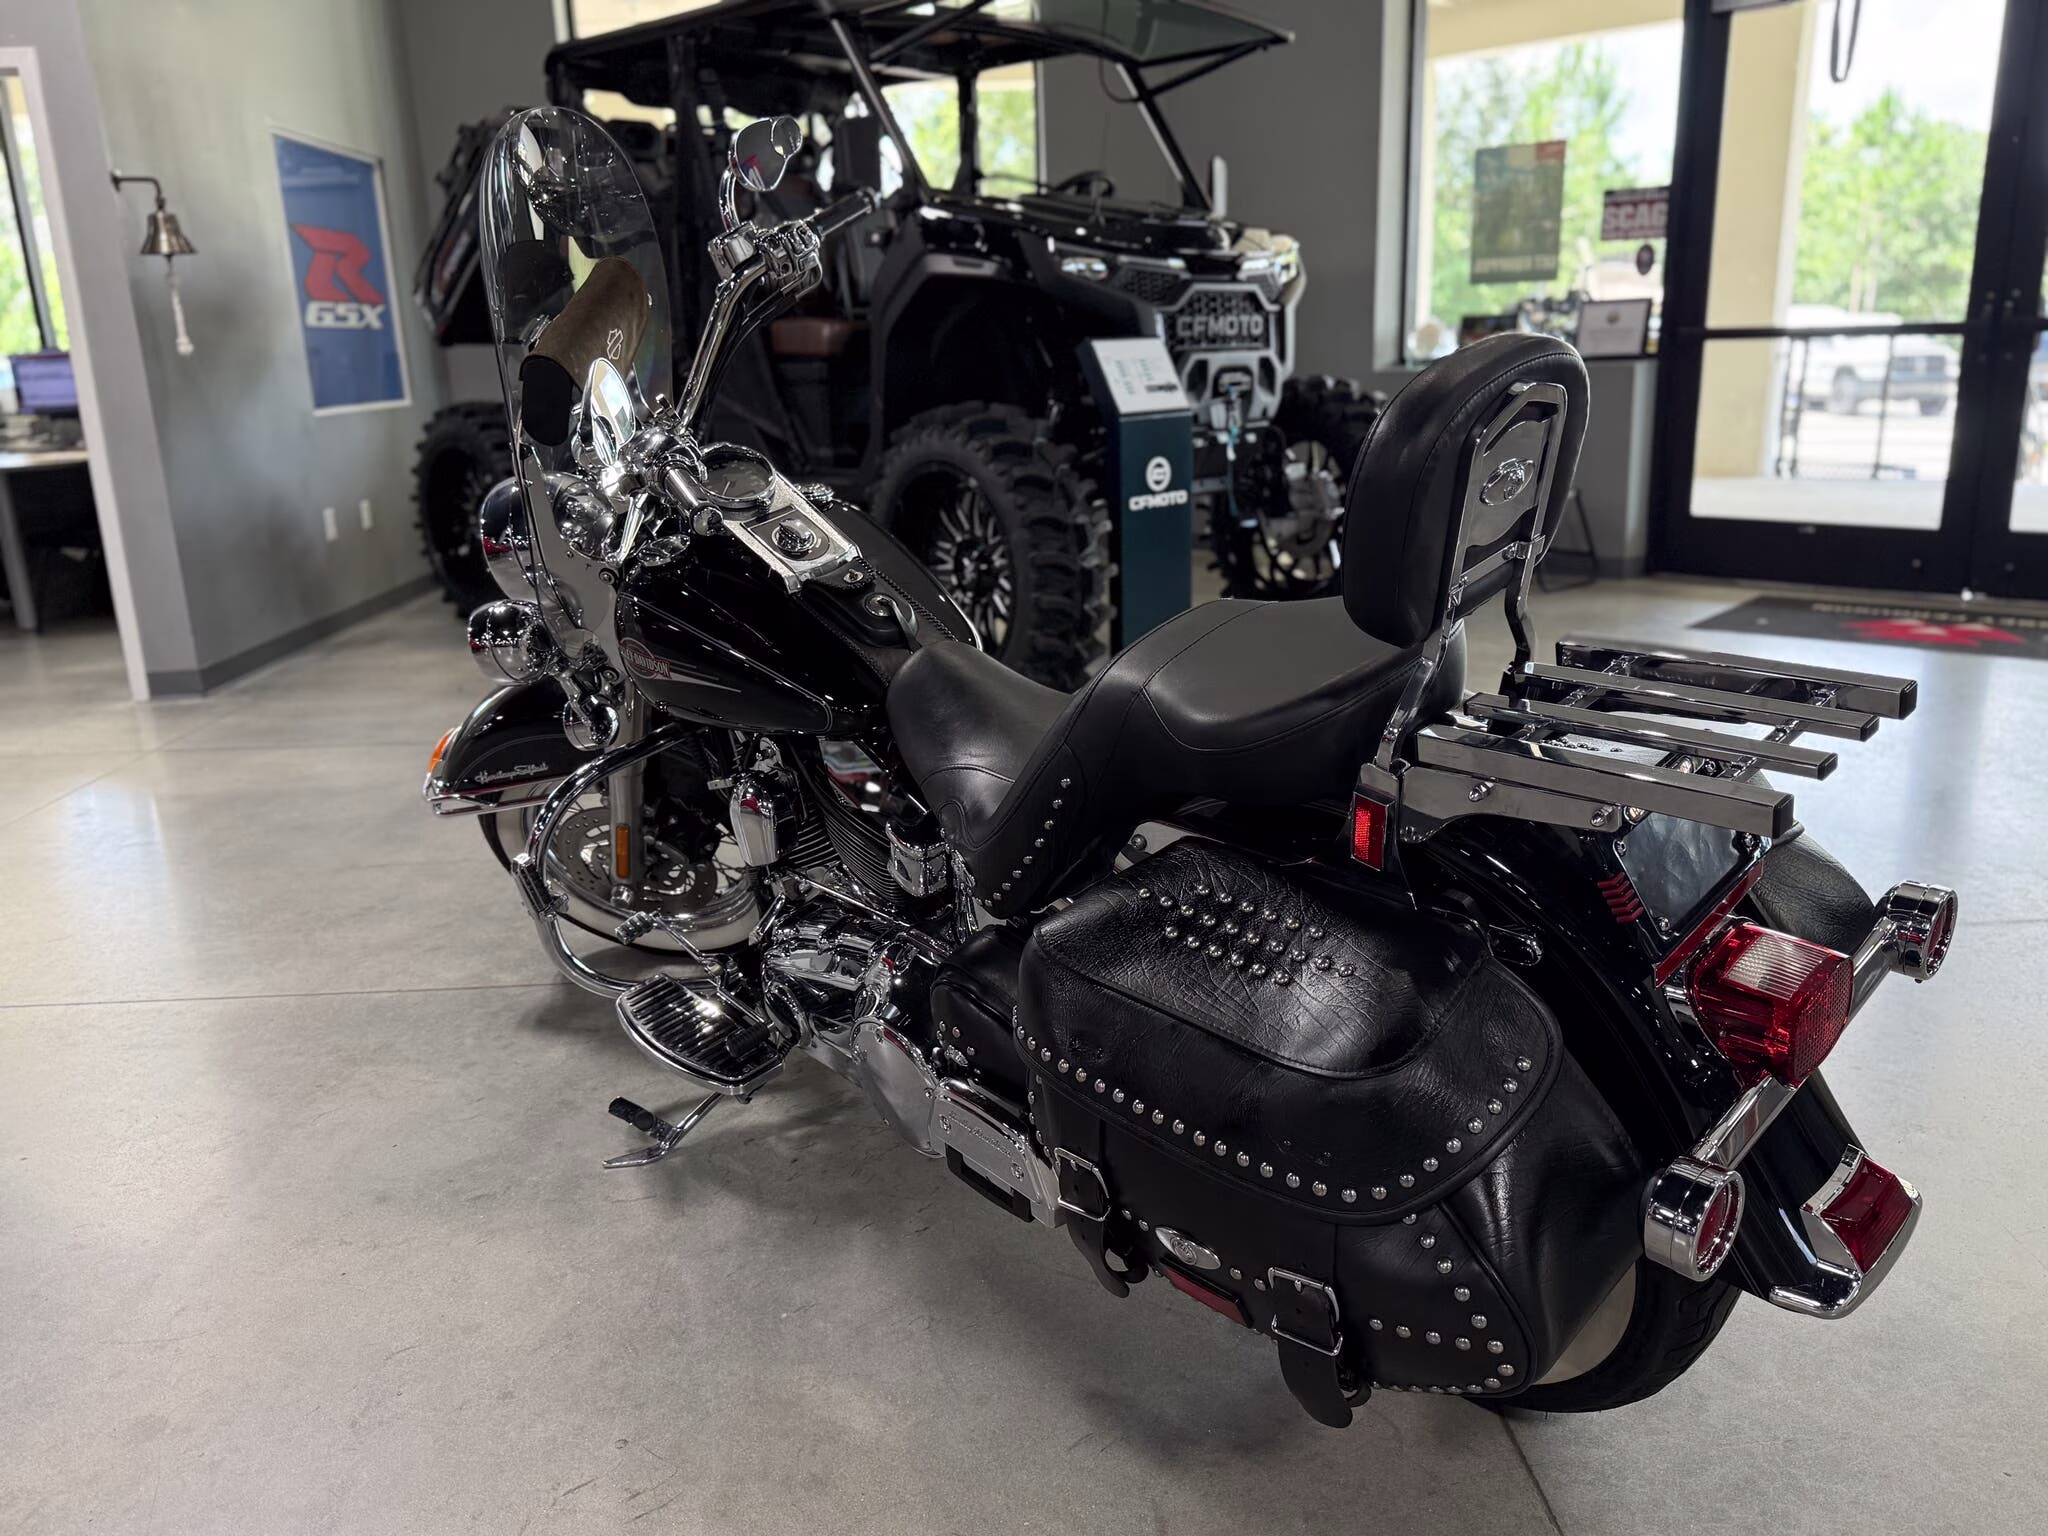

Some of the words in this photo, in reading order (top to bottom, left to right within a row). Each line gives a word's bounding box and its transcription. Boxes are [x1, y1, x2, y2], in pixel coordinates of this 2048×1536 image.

[1604, 202, 1668, 229] SCAG
[304, 301, 386, 330] GSX
[1177, 314, 1264, 338] CFMOTO
[1129, 490, 1188, 511] CFMOTO
